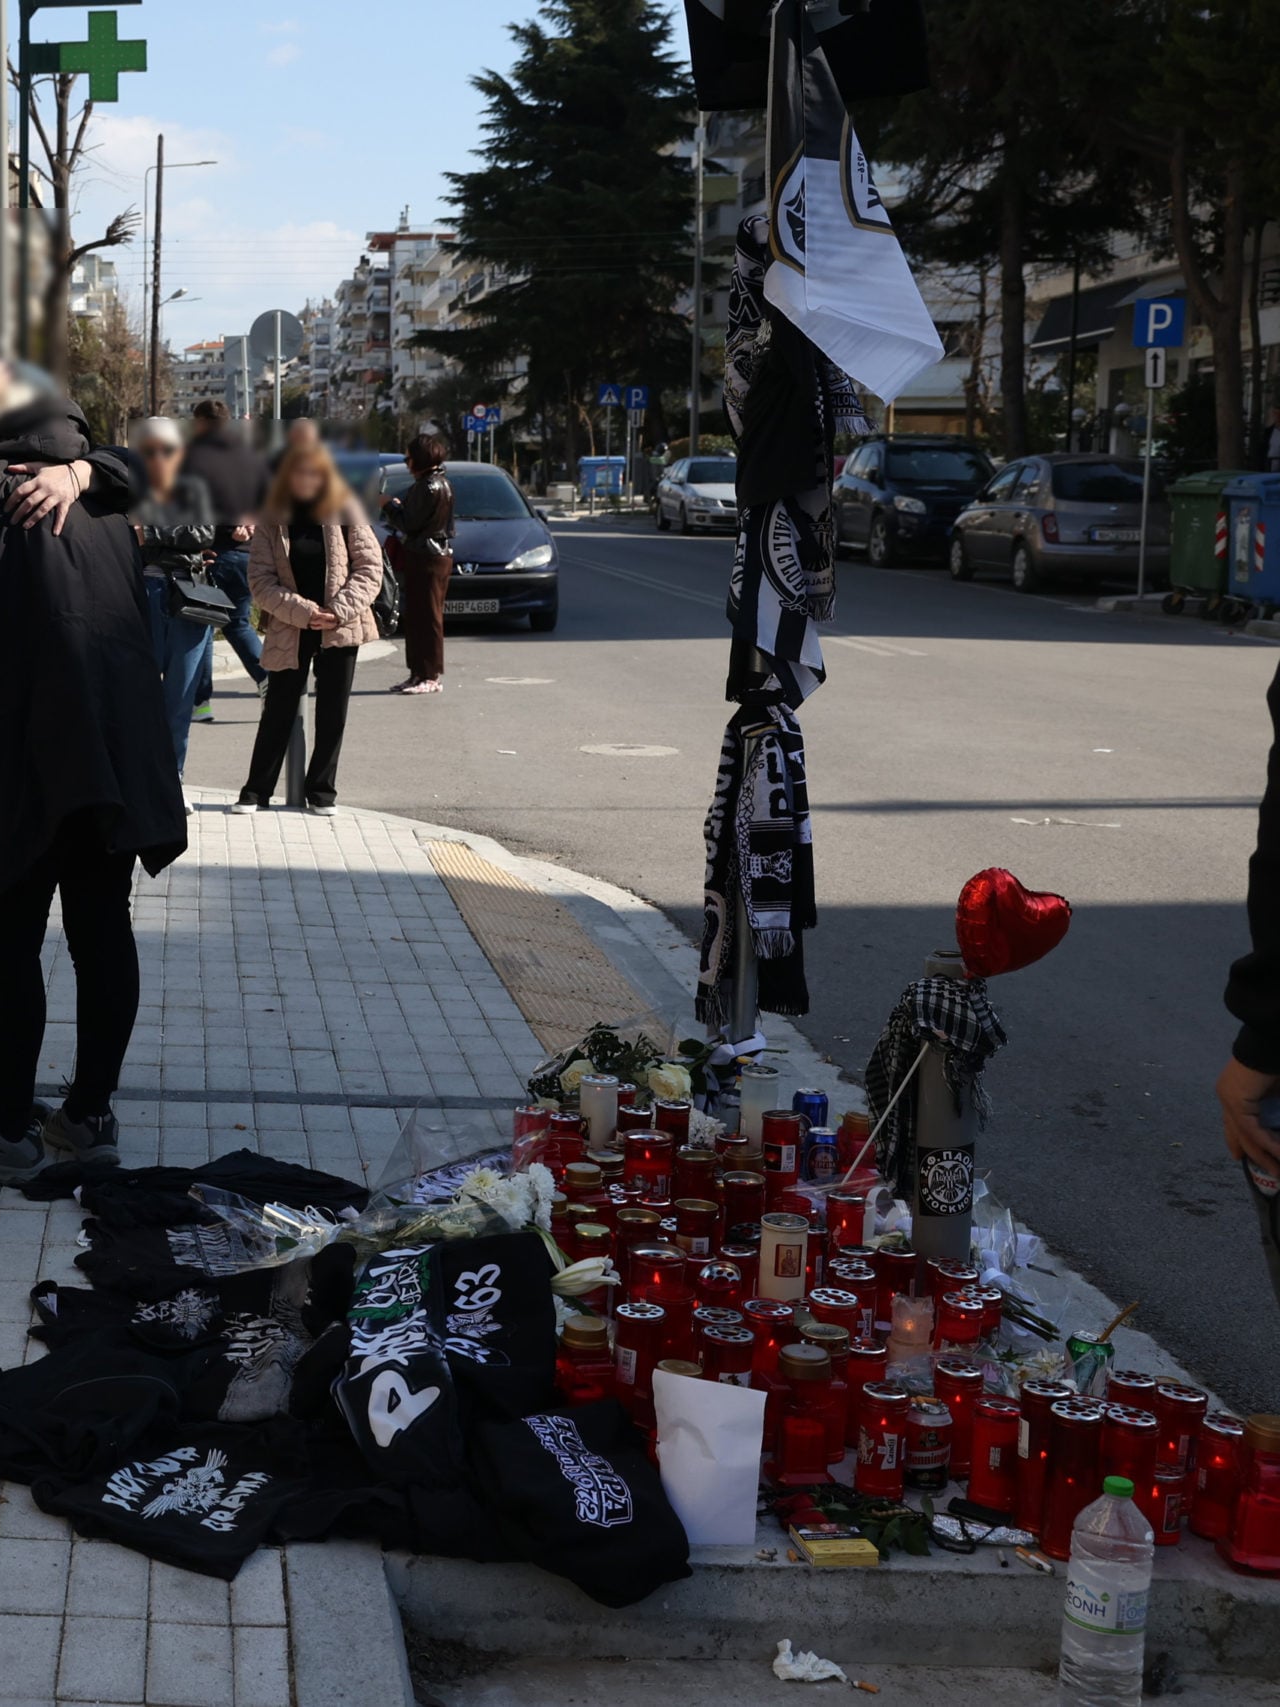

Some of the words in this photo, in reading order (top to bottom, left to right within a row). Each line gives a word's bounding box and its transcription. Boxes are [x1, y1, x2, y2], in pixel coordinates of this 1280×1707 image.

[1146, 303, 1173, 344] P
[631, 388, 644, 408] P
[777, 554, 805, 592] CLUB
[454, 1264, 502, 1310] 63
[1067, 1591, 1106, 1617] ΕΟΝΗ
